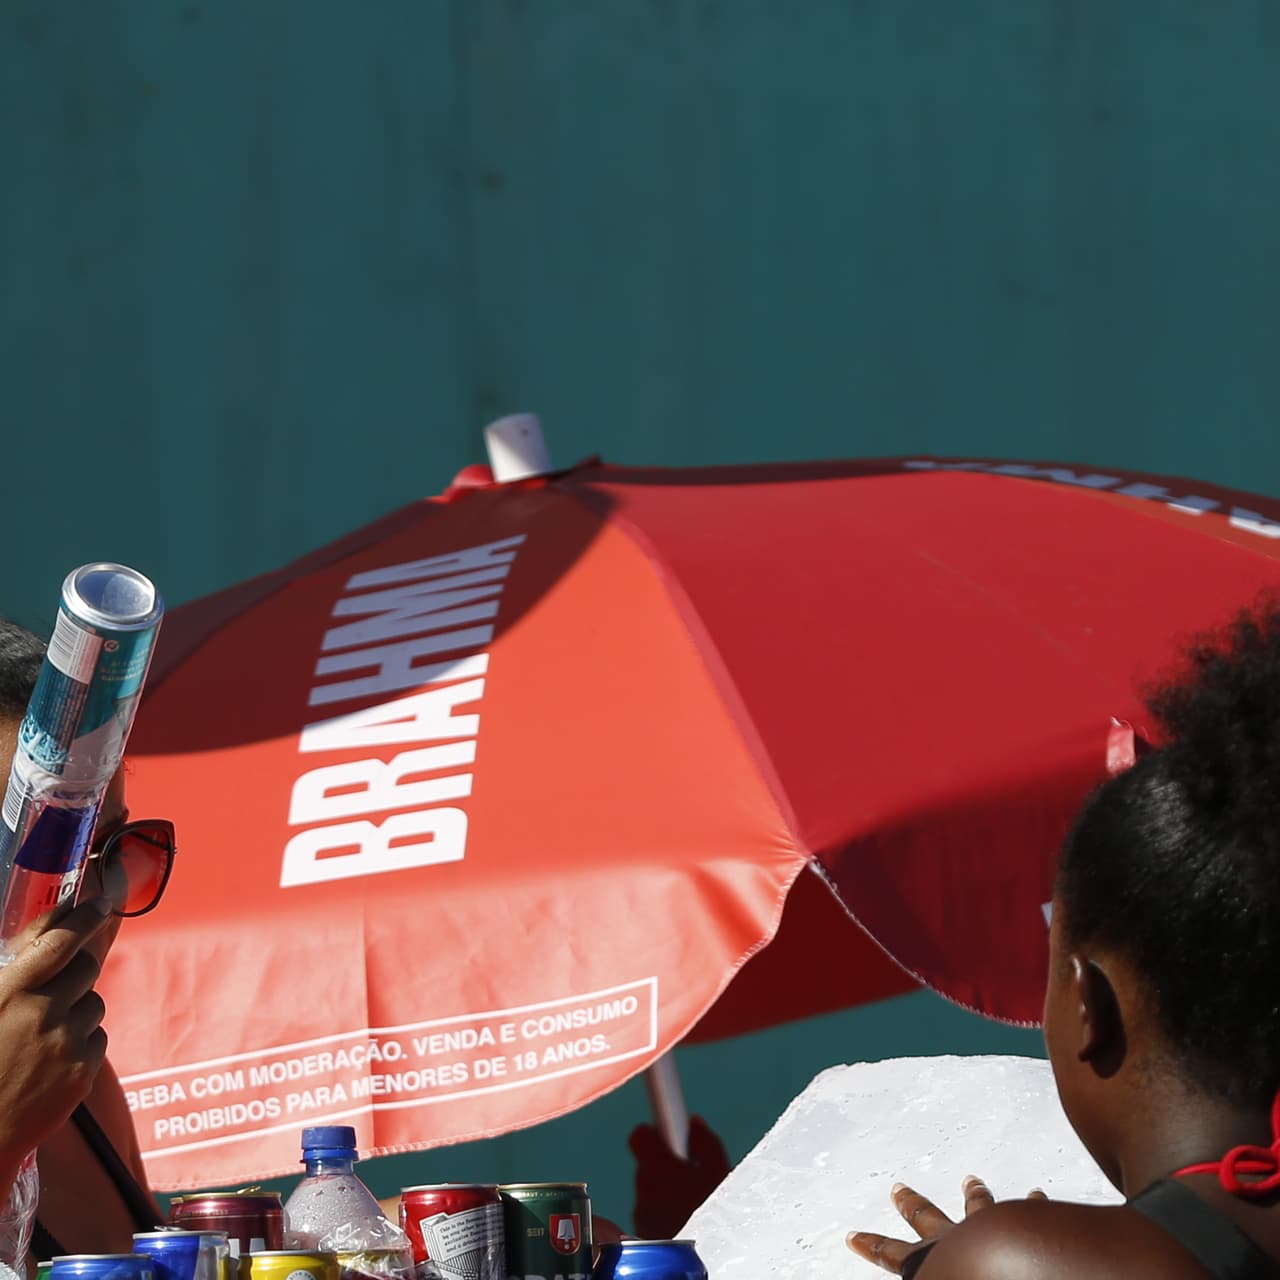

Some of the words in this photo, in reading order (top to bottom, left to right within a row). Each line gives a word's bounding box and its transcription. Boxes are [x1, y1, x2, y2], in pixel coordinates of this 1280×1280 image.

[280, 534, 527, 888] BRAHMA
[154, 1100, 281, 1139] PROIBIDOS
[287, 1083, 346, 1113] PARA
[352, 1062, 468, 1099] MENORES
[474, 1058, 507, 1080] DE
[513, 1051, 537, 1072] 18
[543, 1034, 611, 1064] ANOS.
[190, 1070, 244, 1097] COM
[250, 1038, 407, 1087] MODERAÇÃO.
[413, 1024, 494, 1057] VENDA
[500, 1023, 516, 1043] E
[522, 996, 638, 1039] CONSUMO
